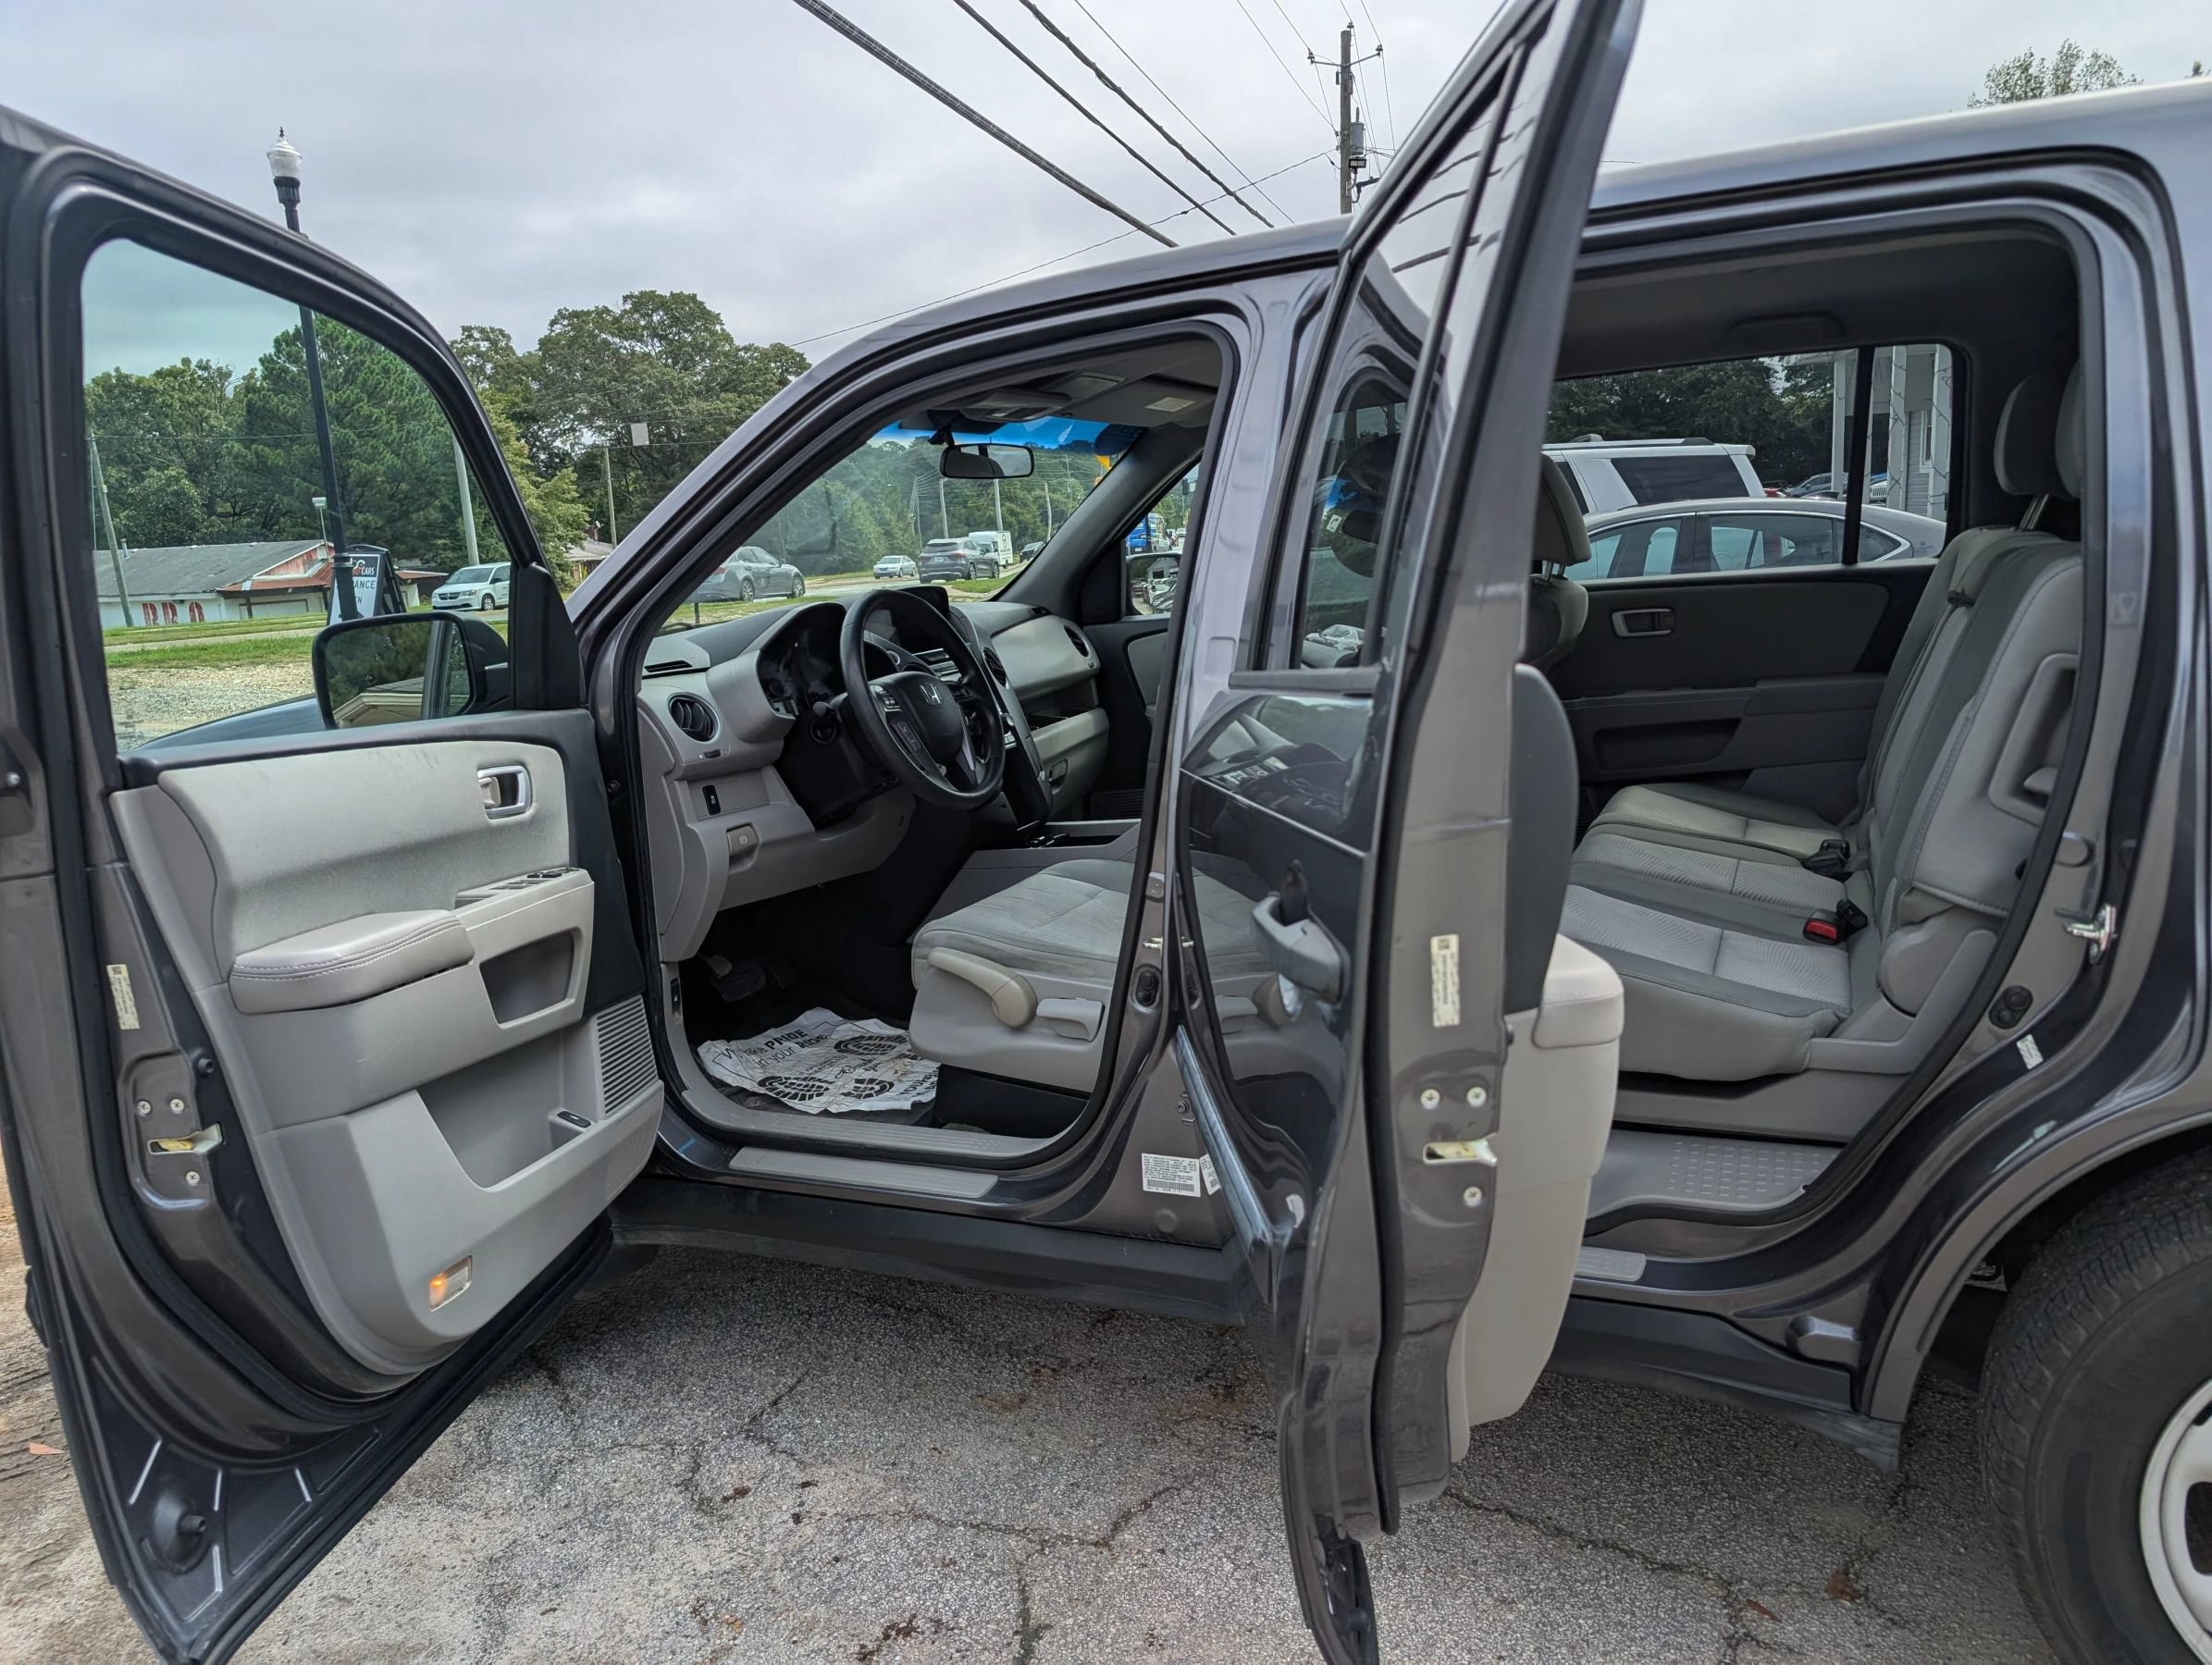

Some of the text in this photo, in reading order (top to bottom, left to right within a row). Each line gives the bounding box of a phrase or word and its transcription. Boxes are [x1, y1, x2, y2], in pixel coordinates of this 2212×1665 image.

[763, 1029, 809, 1050] PRIDE
[752, 1058, 770, 1068] in
[767, 1046, 797, 1063] your
